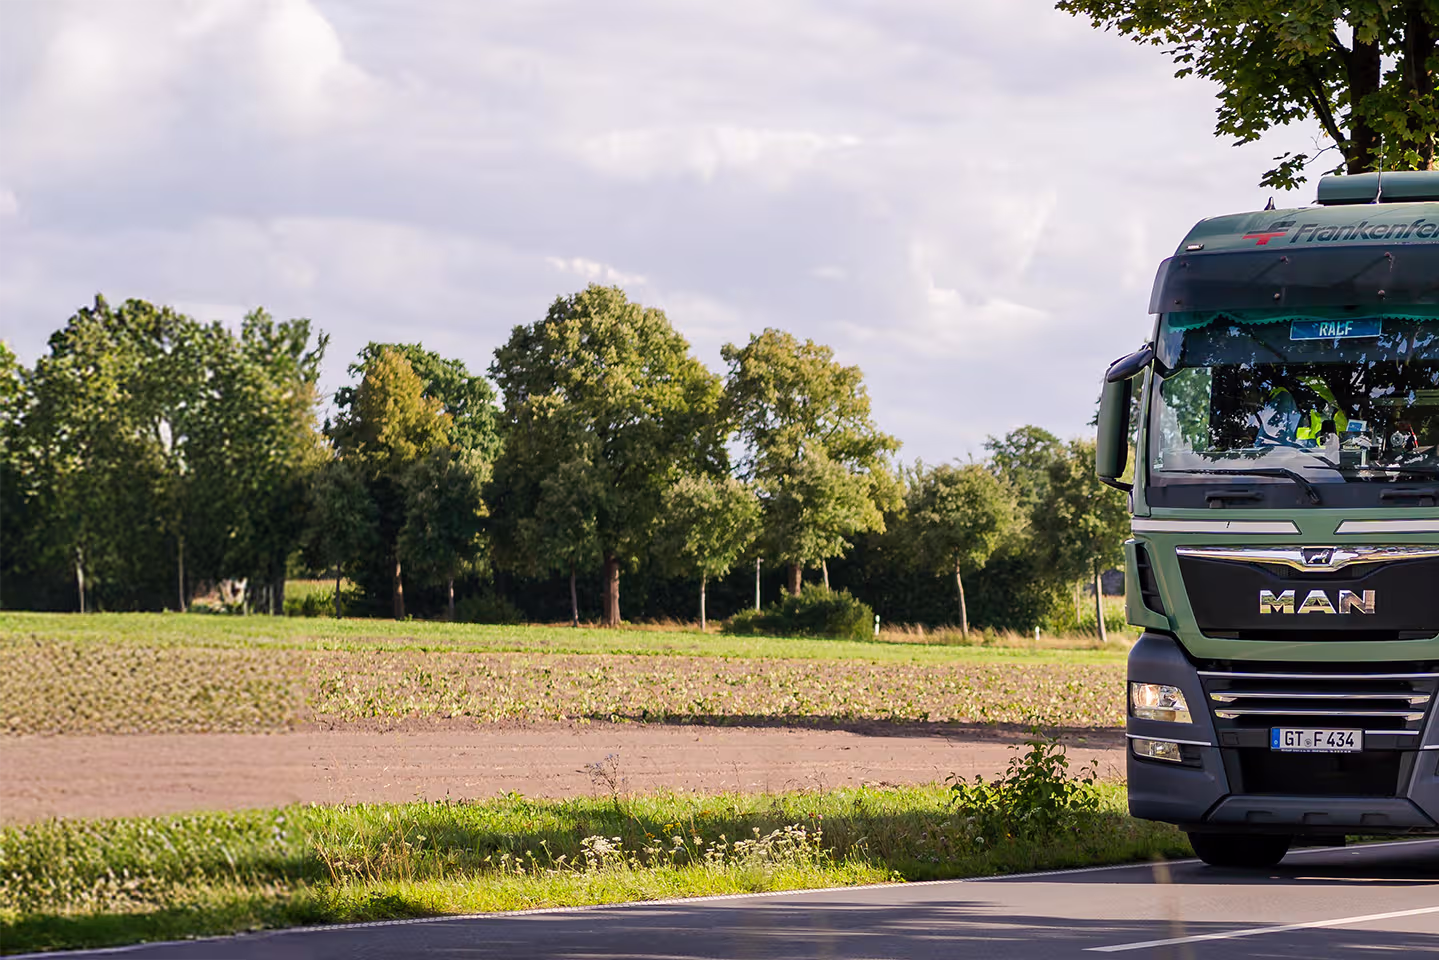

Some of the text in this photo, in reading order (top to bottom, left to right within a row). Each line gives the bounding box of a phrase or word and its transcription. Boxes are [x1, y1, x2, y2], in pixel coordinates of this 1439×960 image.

[1319, 321, 1354, 336] RALF
[1260, 589, 1376, 614] MAN
[1284, 731, 1354, 747] GT F 434
